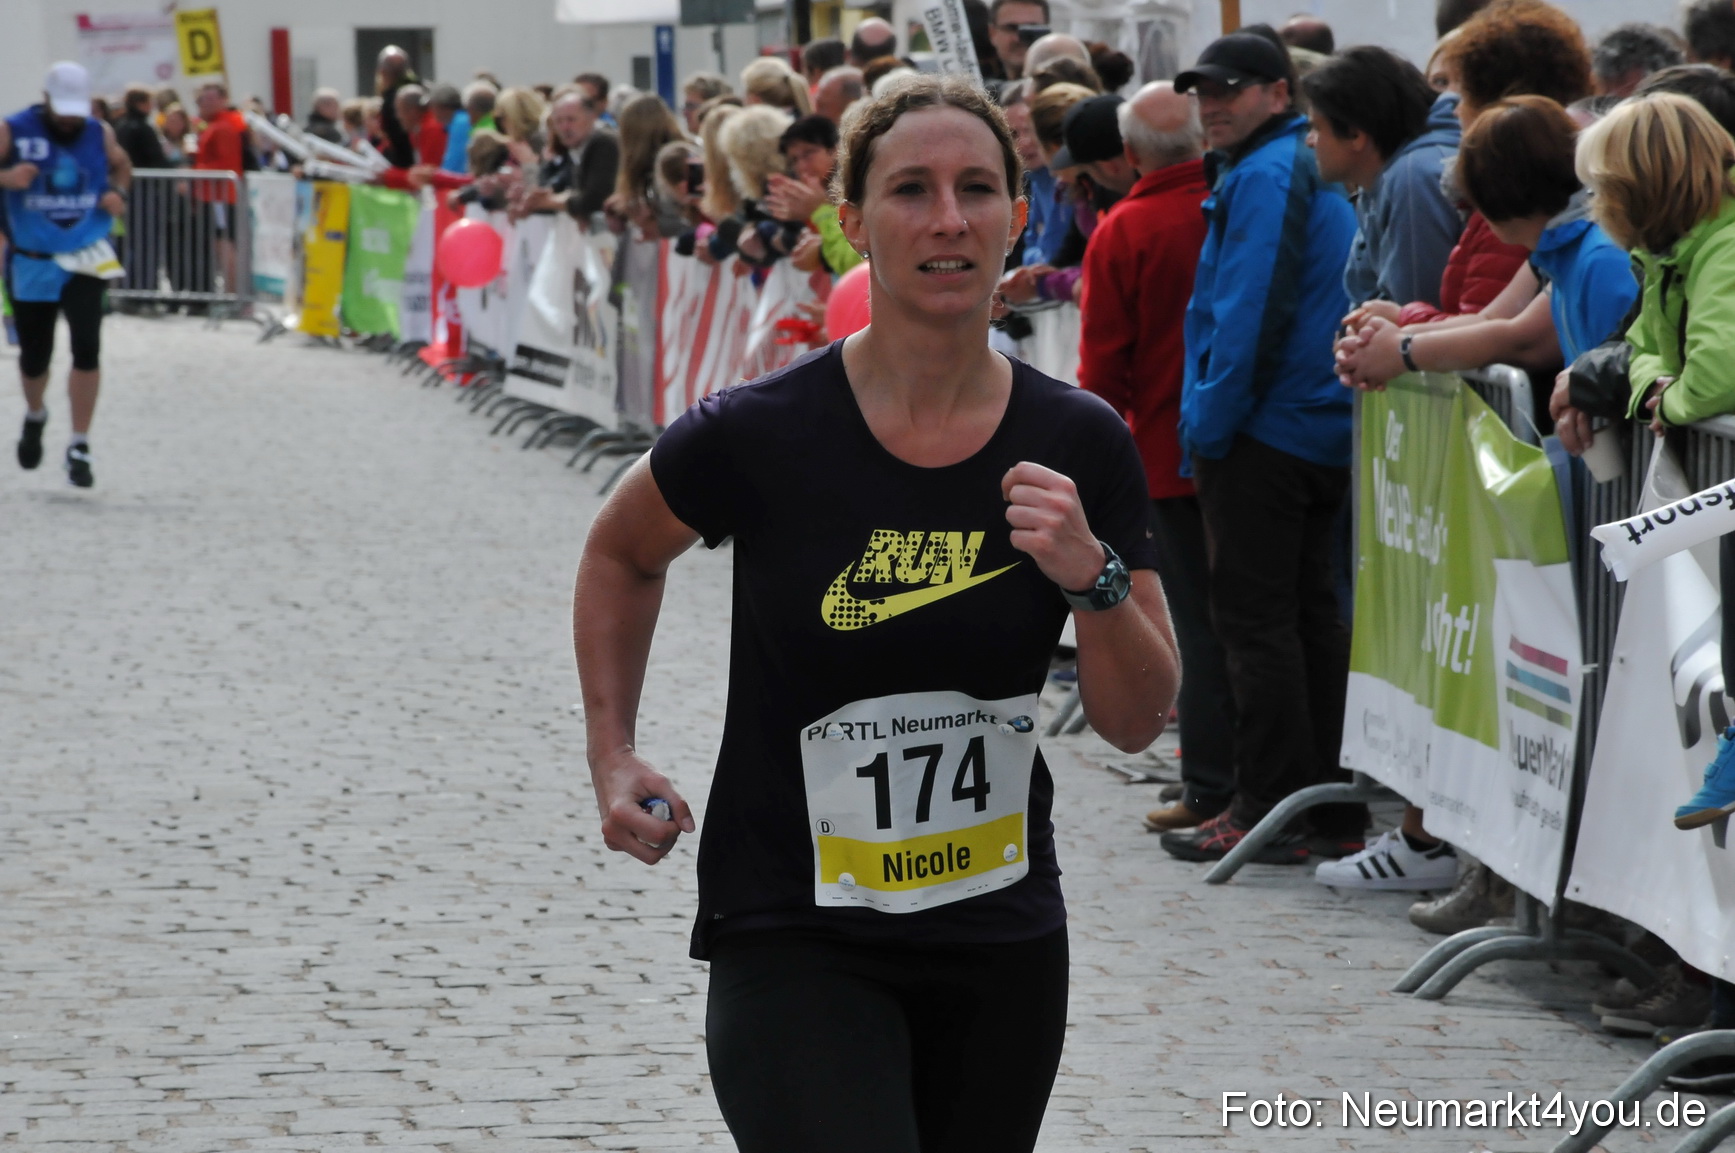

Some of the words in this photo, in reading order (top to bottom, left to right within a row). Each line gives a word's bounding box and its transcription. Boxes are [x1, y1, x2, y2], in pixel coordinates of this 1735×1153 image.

[188, 29, 213, 62] D
[15, 136, 50, 161] 13
[853, 529, 986, 585] RUN
[892, 709, 999, 737] Neumarkt
[855, 735, 991, 831] 174
[821, 821, 830, 833] D
[882, 842, 971, 883] Nicole
